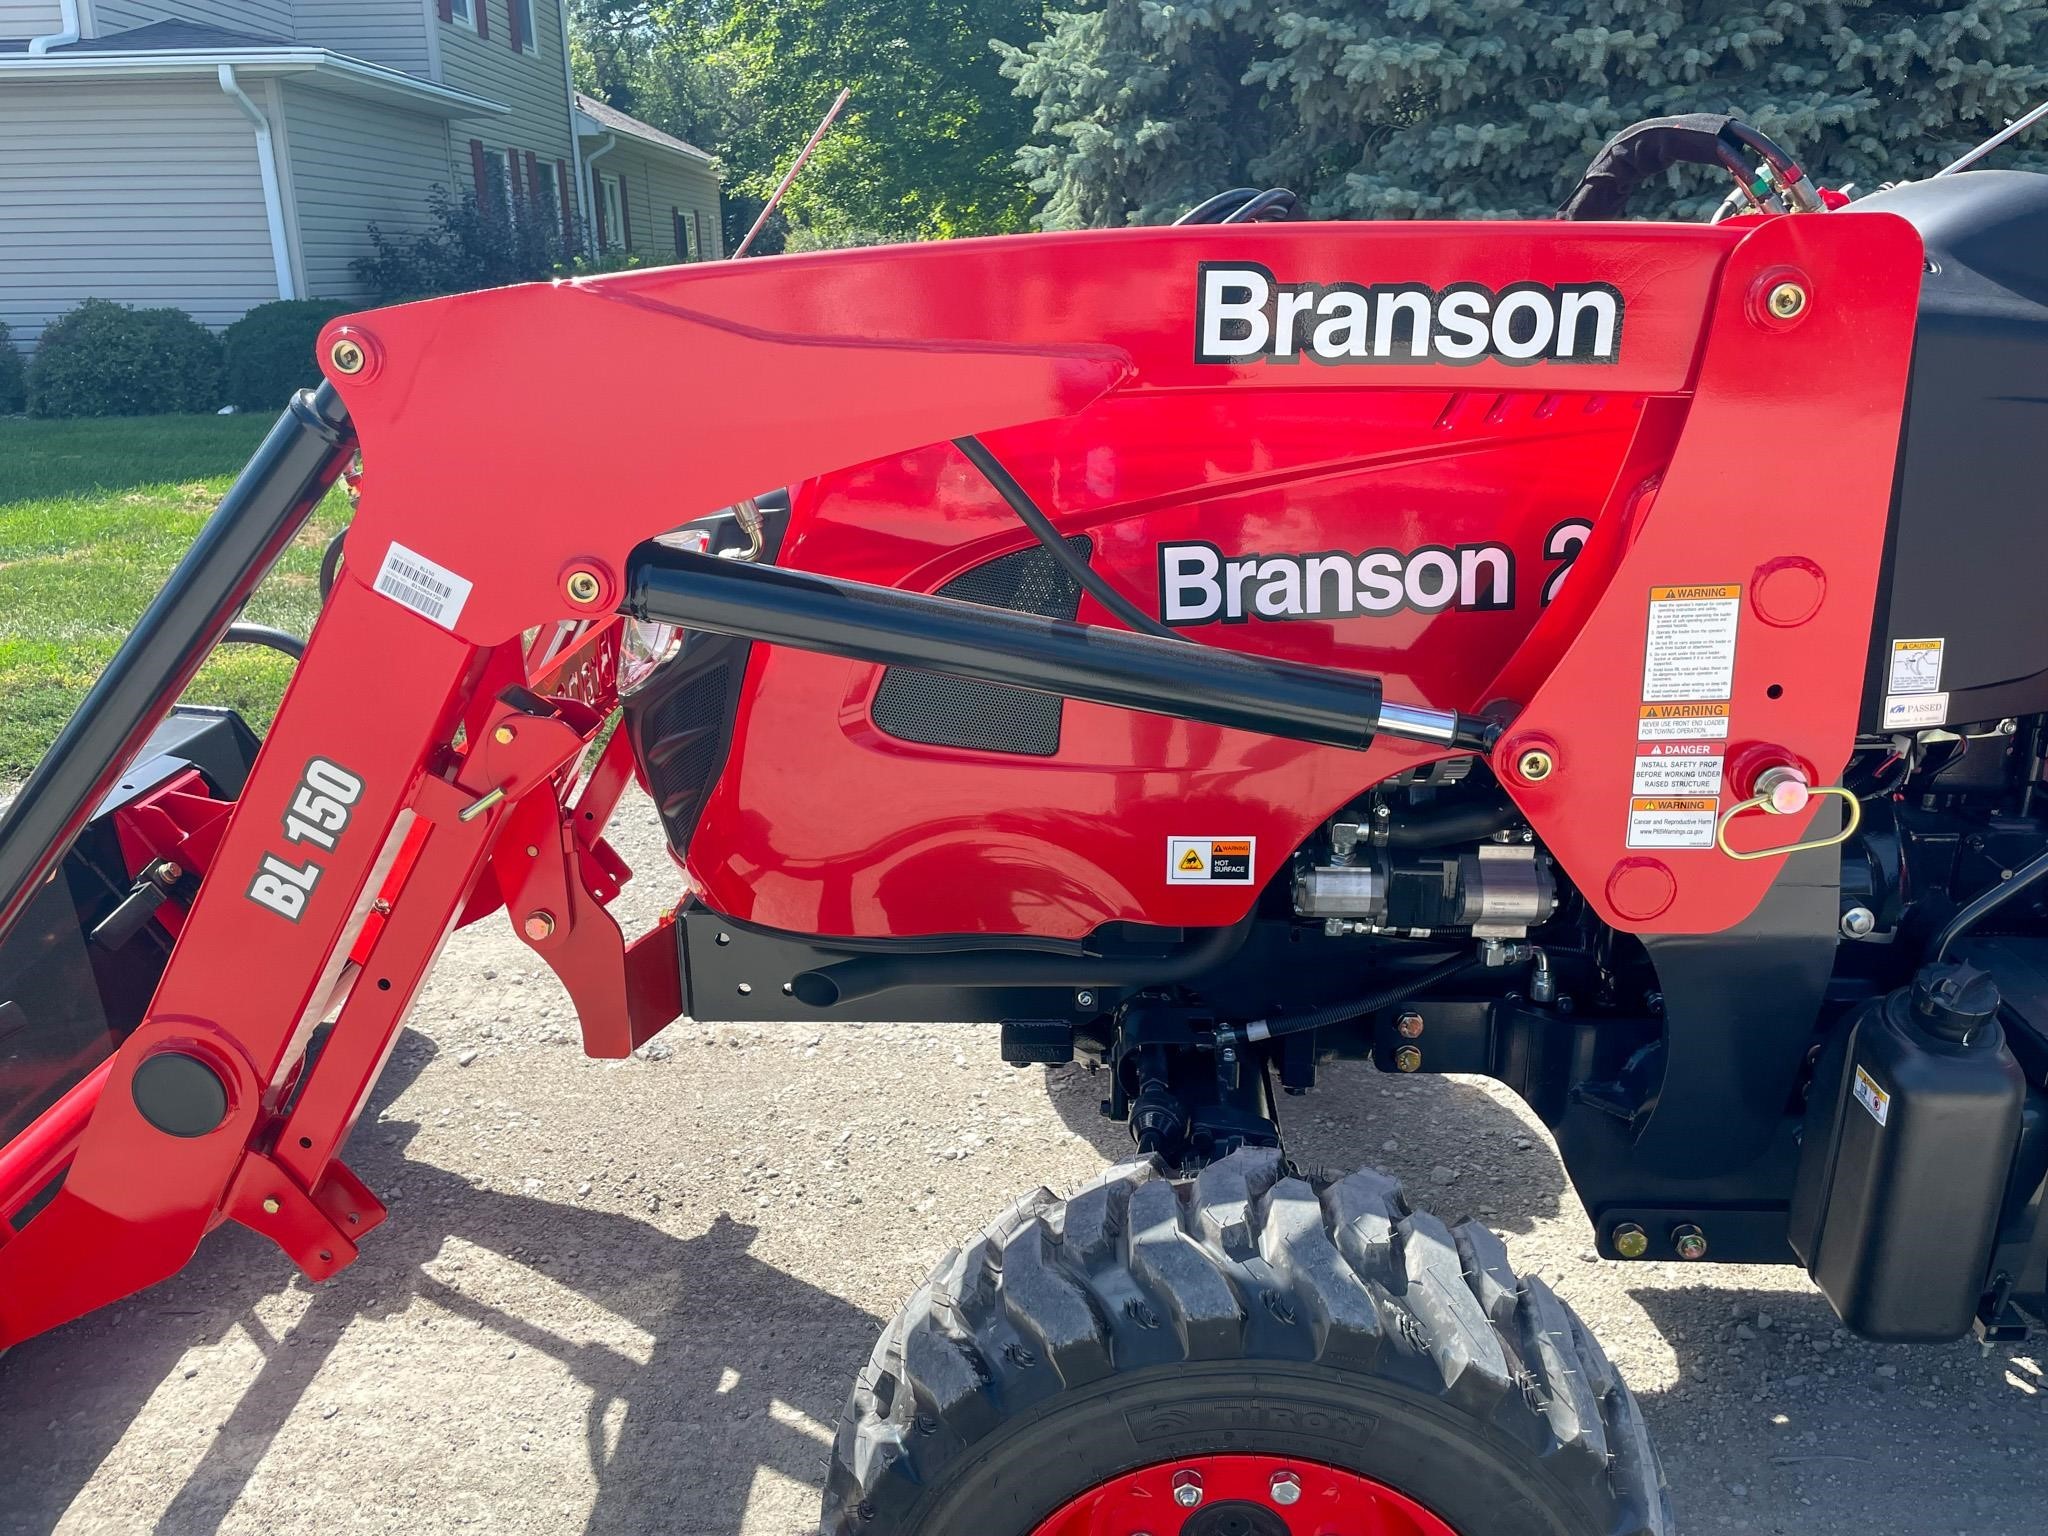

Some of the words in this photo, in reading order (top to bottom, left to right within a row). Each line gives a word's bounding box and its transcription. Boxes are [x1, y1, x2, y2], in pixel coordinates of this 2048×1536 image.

[1200, 268, 1619, 361] Branson
[1161, 543, 1511, 623] Branson
[1677, 587, 1726, 598] WARNING
[1661, 705, 1723, 717] WARNING
[1908, 704, 1942, 713] PASSED
[1665, 745, 1710, 754] DANGER
[284, 758, 363, 851] 150
[1658, 801, 1704, 809] WARNING
[248, 854, 321, 921] BL
